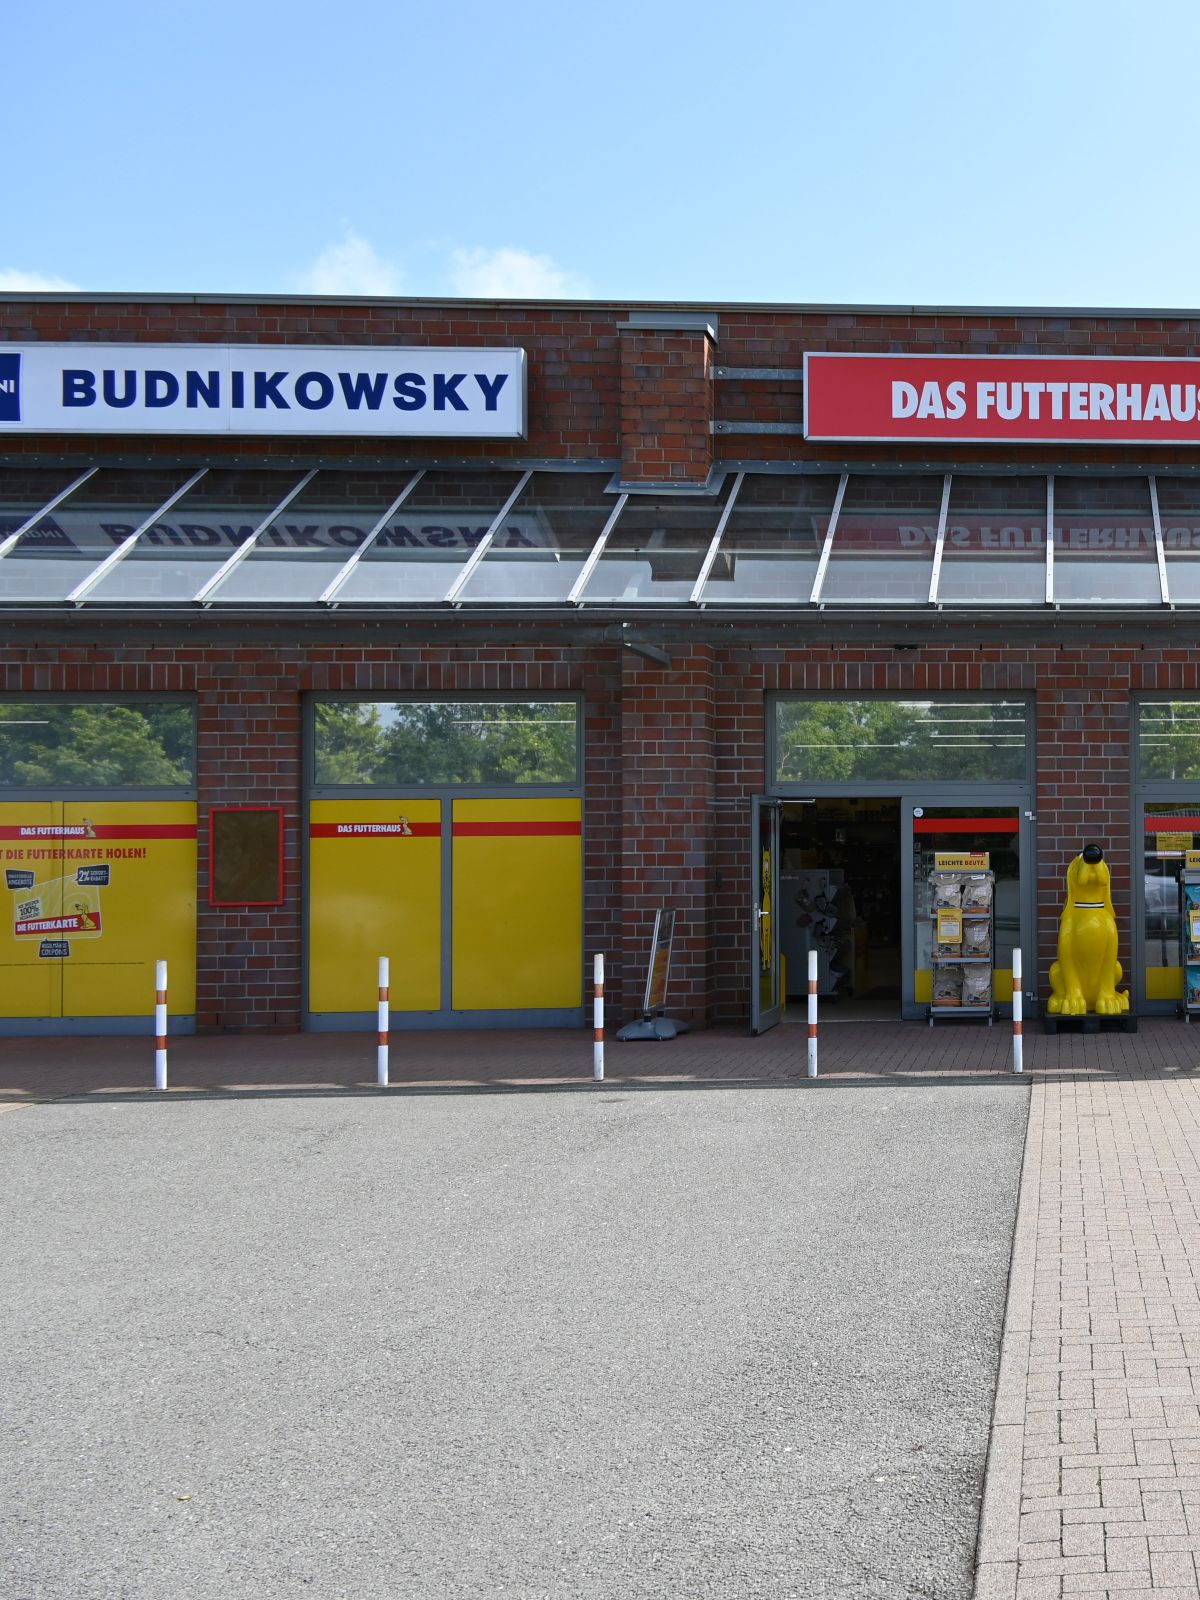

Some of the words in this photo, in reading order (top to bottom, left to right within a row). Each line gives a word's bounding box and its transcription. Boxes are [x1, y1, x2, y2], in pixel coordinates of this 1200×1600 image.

[62, 369, 509, 411] BUDNIKOWSKY
[891, 381, 967, 420] DAS
[20, 827, 36, 836] DAS
[37, 826, 85, 835] FUTTERHAUS
[337, 825, 353, 833] DAS
[354, 824, 401, 833] FUTTERHAUS
[6, 849, 24, 859] DIE
[27, 848, 103, 859] FUTTERKARTE
[106, 848, 147, 859] HOLEN!
[16, 924, 27, 932] DIE
[27, 918, 78, 931] FUTTERKARTE
